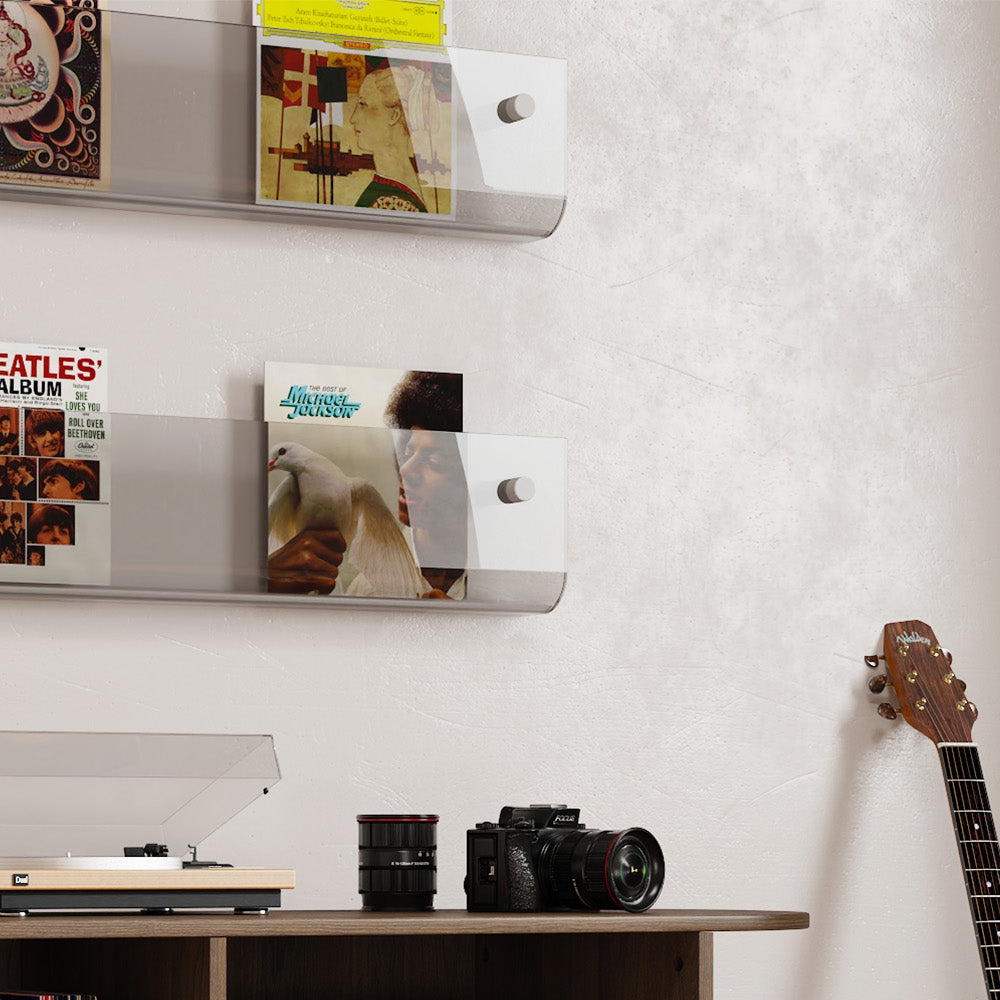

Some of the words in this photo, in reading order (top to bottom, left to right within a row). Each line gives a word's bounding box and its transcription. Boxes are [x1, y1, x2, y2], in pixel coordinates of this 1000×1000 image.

[75, 391, 88, 401] SHE
[65, 401, 86, 411] LOVES
[87, 403, 101, 412] YOU
[68, 417, 85, 428] ROLL
[86, 419, 104, 429] OVER
[67, 428, 105, 440] BEETHOVEN
